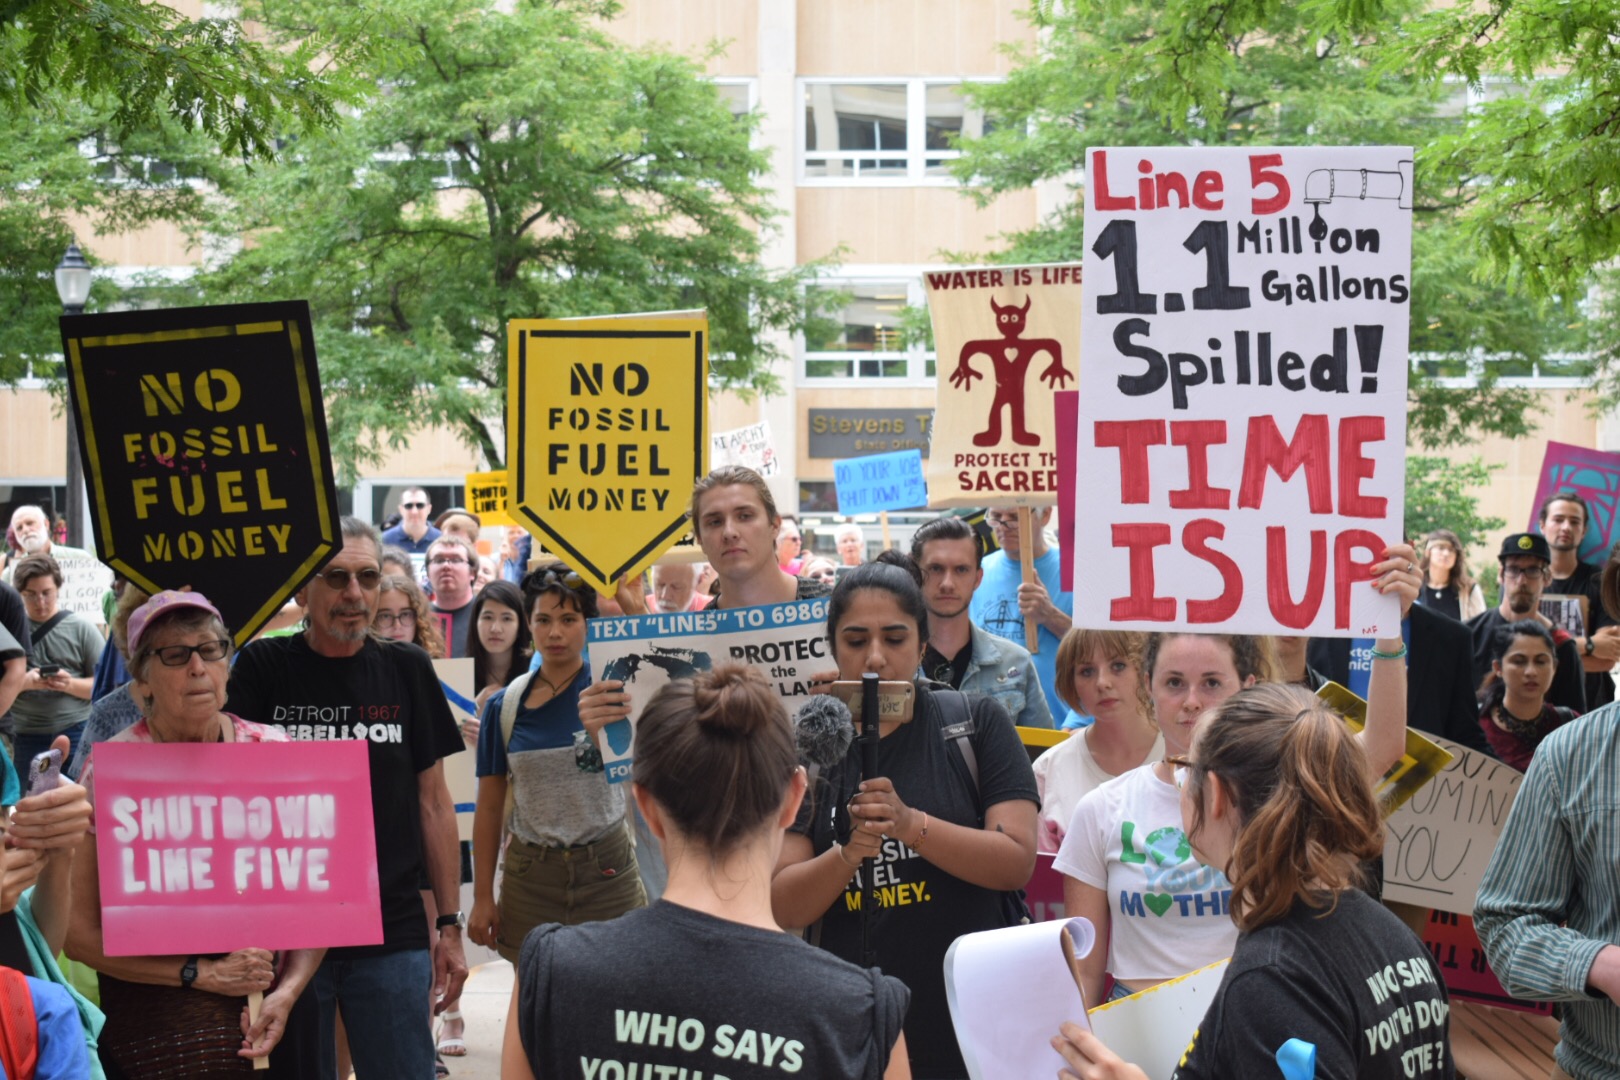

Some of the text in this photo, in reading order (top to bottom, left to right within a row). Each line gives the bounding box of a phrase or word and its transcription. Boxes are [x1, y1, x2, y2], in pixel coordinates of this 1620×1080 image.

[1092, 150, 1291, 215] Line 5
[928, 266, 1083, 291] WATER IS LIFE
[1091, 219, 1251, 315] 1.1
[1261, 265, 1409, 306] Gallons
[570, 362, 650, 396] NO
[1113, 317, 1384, 410] Spilled!
[139, 368, 241, 417] NO
[549, 407, 670, 431] FOSSIL
[813, 415, 905, 434] Stevens
[123, 423, 278, 463] FOSSIL
[548, 443, 670, 476] FUEL
[855, 439, 888, 450] State
[954, 452, 1031, 468] PROTECT
[860, 460, 891, 480] YOUR
[896, 457, 920, 476] JOB
[957, 470, 1058, 492] SACRED
[1094, 413, 1389, 519] TIME
[131, 468, 288, 520] FUEL
[549, 487, 670, 512] MONEY
[143, 524, 291, 563] MONEY
[1109, 518, 1244, 624] IS
[1265, 525, 1388, 631] UP
[591, 618, 640, 639] TEXT
[734, 609, 765, 629] TO
[770, 666, 797, 679] the
[273, 705, 401, 722] DETROIT 1967
[233, 847, 330, 892] FIVE
[615, 1009, 805, 1073] WHO SAYS
